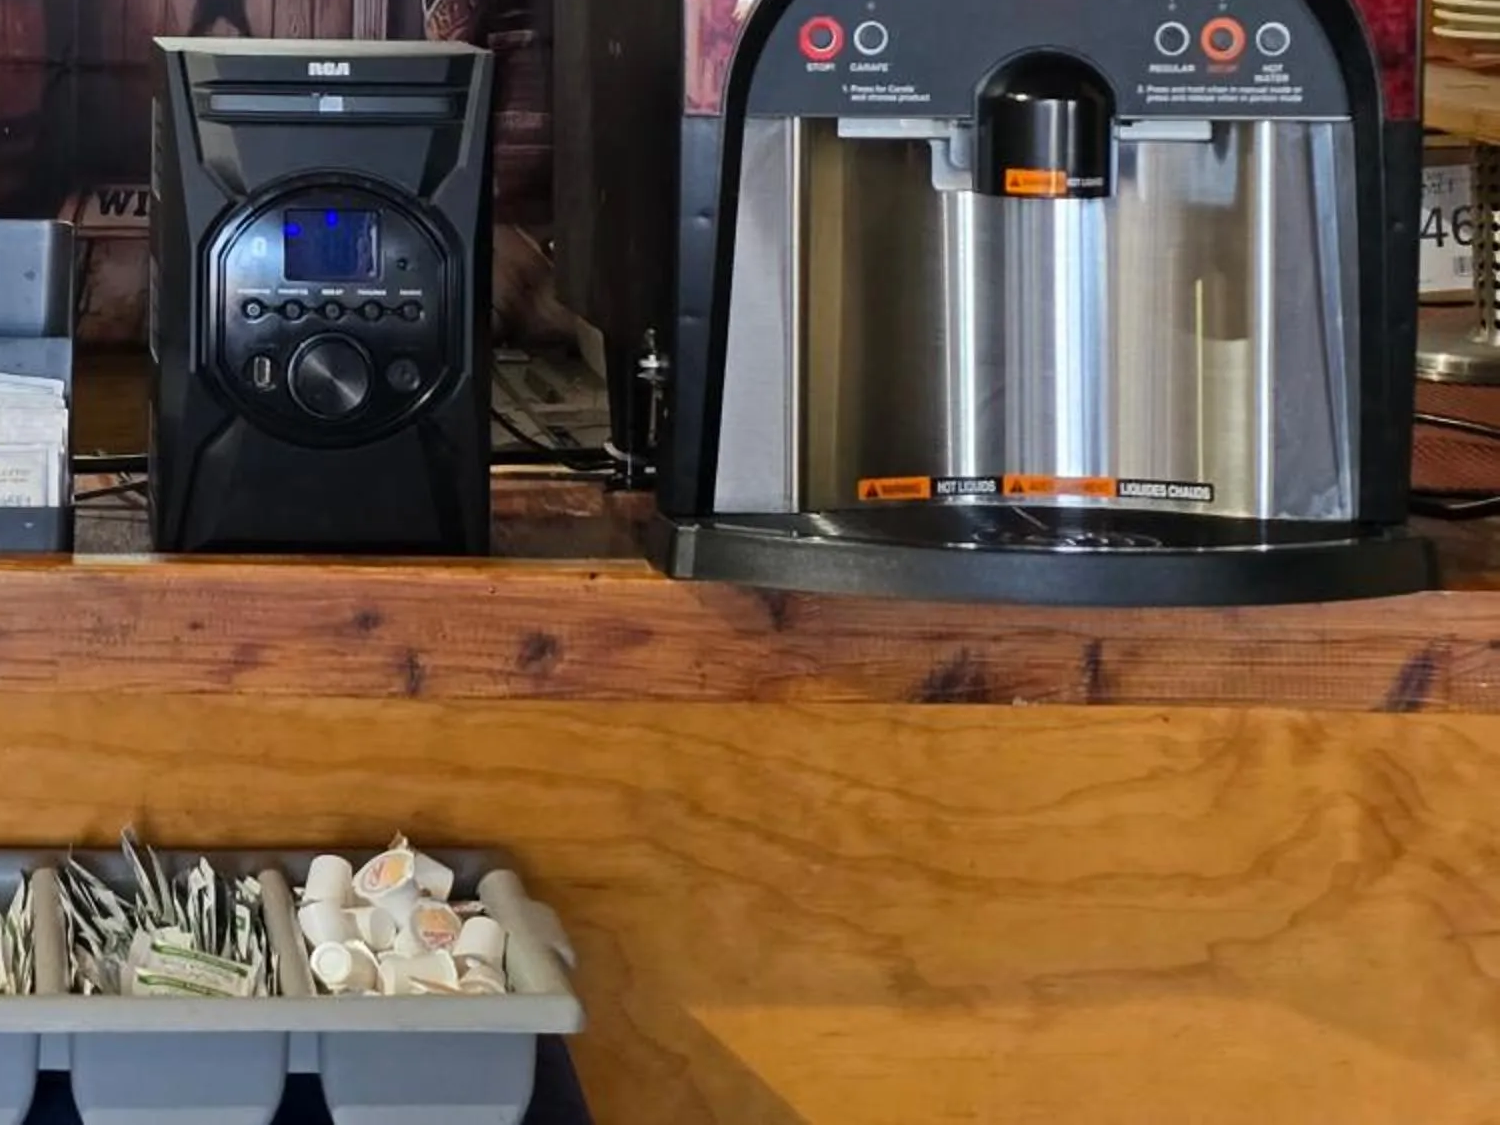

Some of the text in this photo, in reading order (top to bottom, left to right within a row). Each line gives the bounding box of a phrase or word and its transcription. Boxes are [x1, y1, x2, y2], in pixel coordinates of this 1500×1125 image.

[308, 62, 350, 76] RCA
[1148, 63, 1196, 73] REGULAR
[1419, 206, 1473, 247] 46
[938, 480, 995, 493] HOT LIQUIDS
[1120, 483, 1166, 496] LIQUIDES
